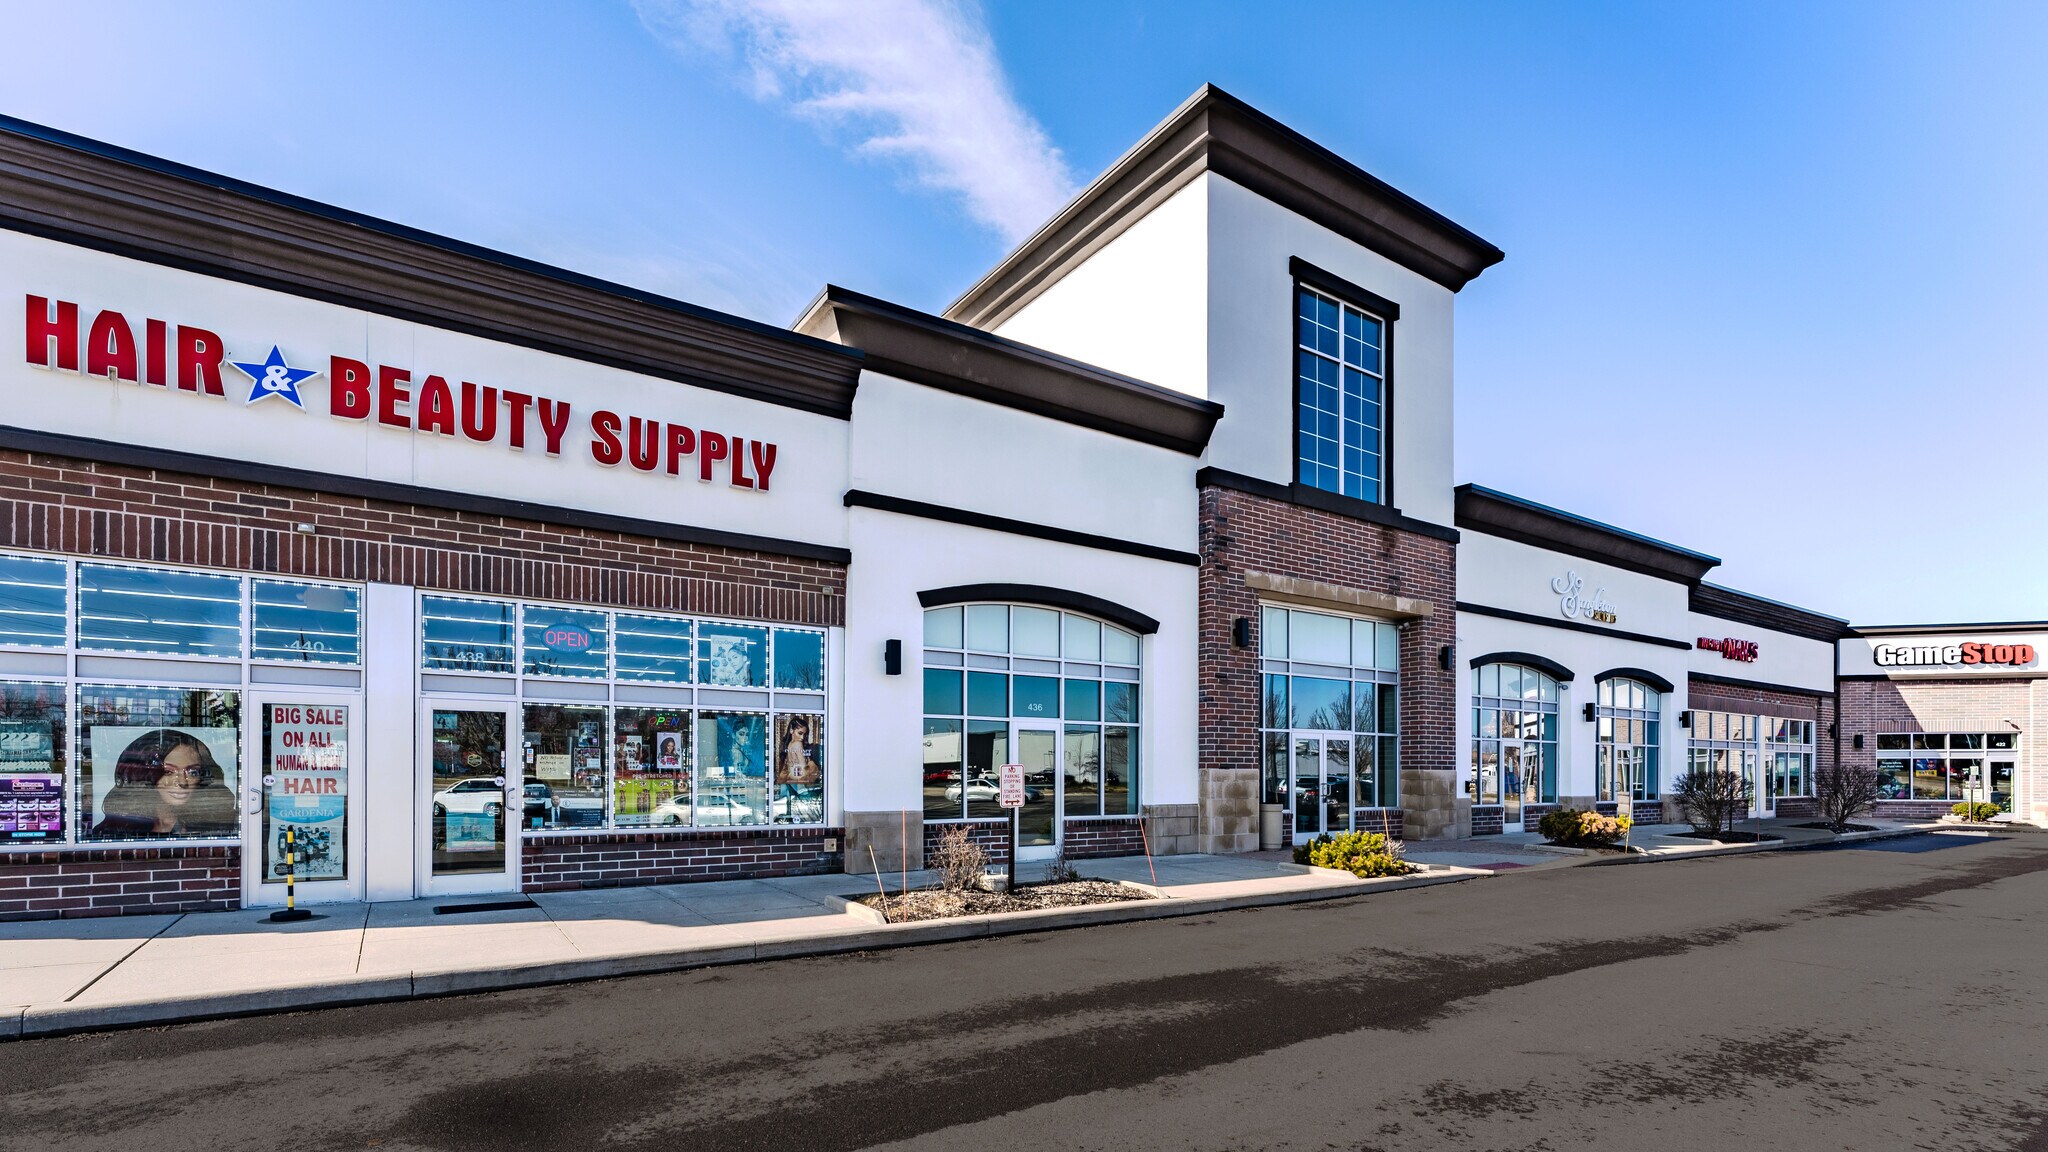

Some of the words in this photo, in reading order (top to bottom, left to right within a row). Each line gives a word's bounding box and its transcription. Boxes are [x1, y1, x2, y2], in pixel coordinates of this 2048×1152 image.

[26, 293, 227, 399] HAIR
[261, 365, 292, 392] &
[330, 355, 571, 458] BEAUTY
[590, 410, 778, 493] SUPPLY
[290, 640, 325, 654] 440
[545, 631, 589, 647] OPEN
[456, 652, 485, 663] 438
[1874, 642, 2035, 666] GameStop
[1027, 703, 1043, 711] 436
[274, 707, 301, 724] BIG
[305, 708, 344, 725] SALE
[648, 716, 680, 726] OPEN
[283, 731, 304, 748] ON
[309, 732, 335, 748] ALL
[276, 755, 308, 771] HUMAN
[284, 777, 338, 795] HAIR
[280, 808, 334, 817] GARDENIA
